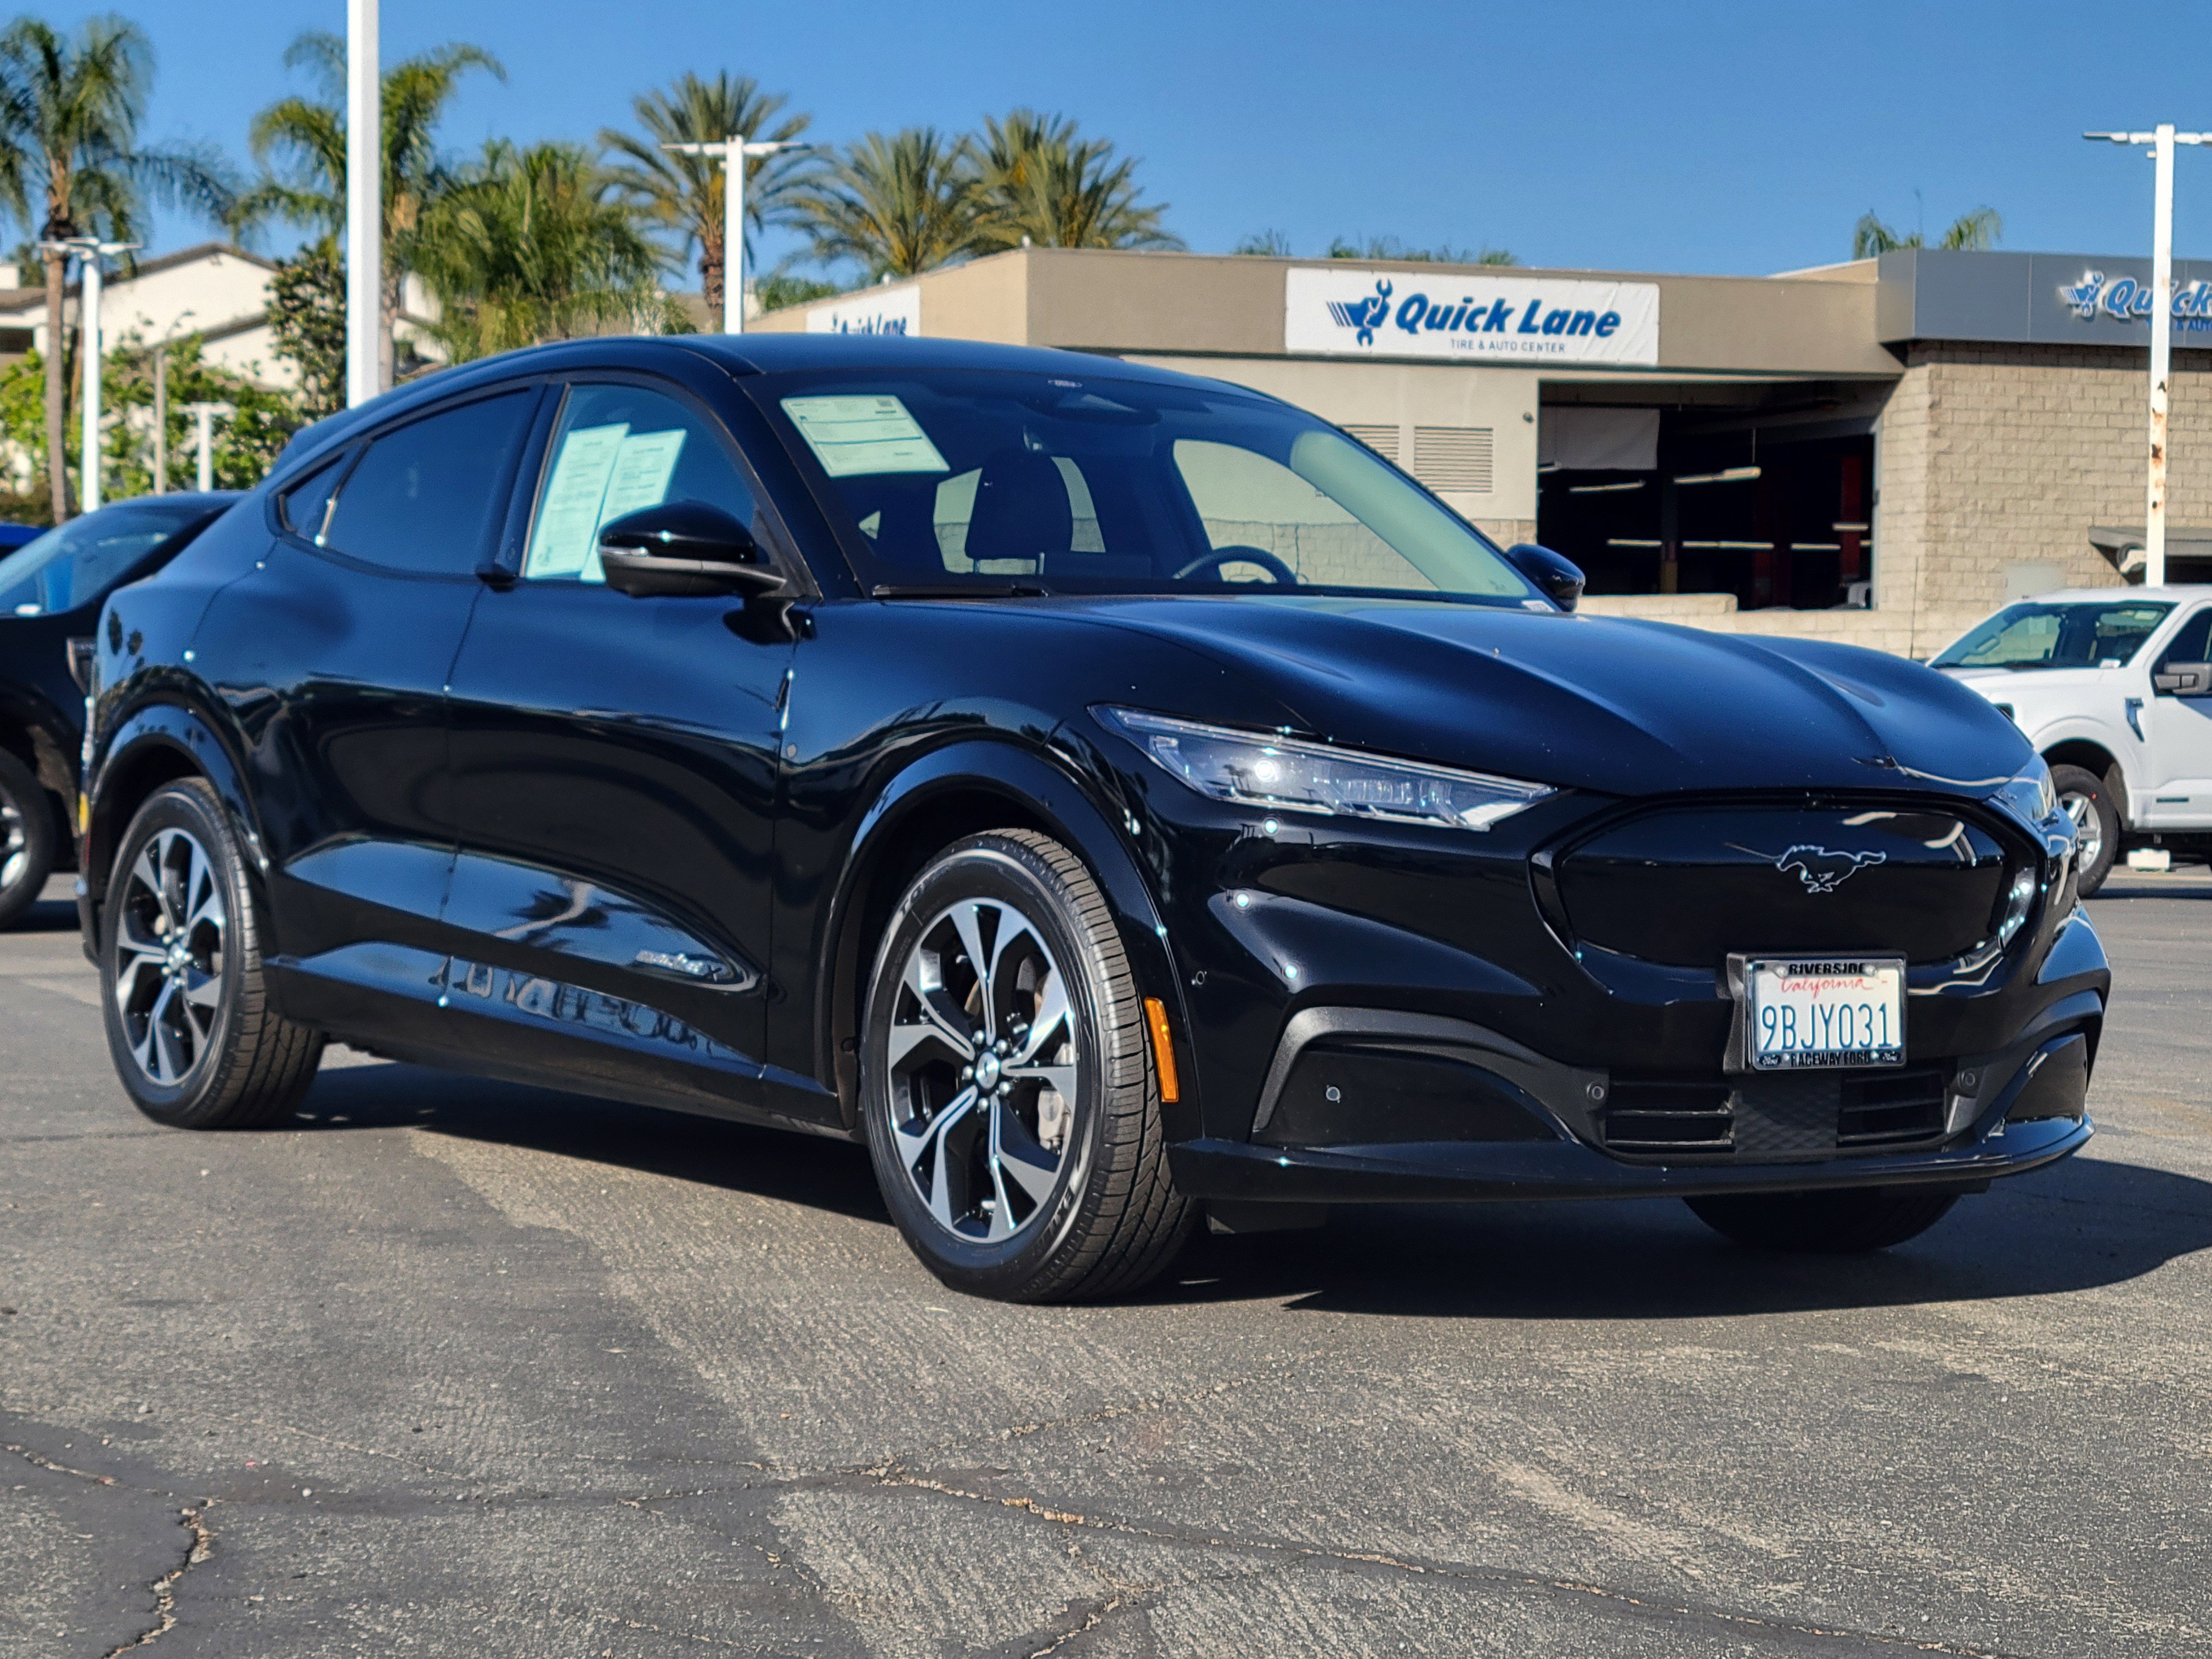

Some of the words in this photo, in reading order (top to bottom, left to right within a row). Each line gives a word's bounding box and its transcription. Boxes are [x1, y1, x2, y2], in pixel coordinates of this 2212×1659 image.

[2107, 277, 2212, 318] Quck
[1395, 293, 1515, 335] Quick
[1517, 298, 1622, 338] Lane
[2188, 318, 2212, 331] AUT
[1451, 338, 1474, 350] TIRE
[1478, 340, 1485, 350] &
[1489, 340, 1517, 352] AUTO
[1521, 341, 1566, 353] CENTER
[1789, 962, 1865, 975] RIVERSIDE
[1781, 976, 1874, 998] California
[1762, 1002, 1892, 1051] 9BJY031
[1791, 1050, 1841, 1067] RACEWAY
